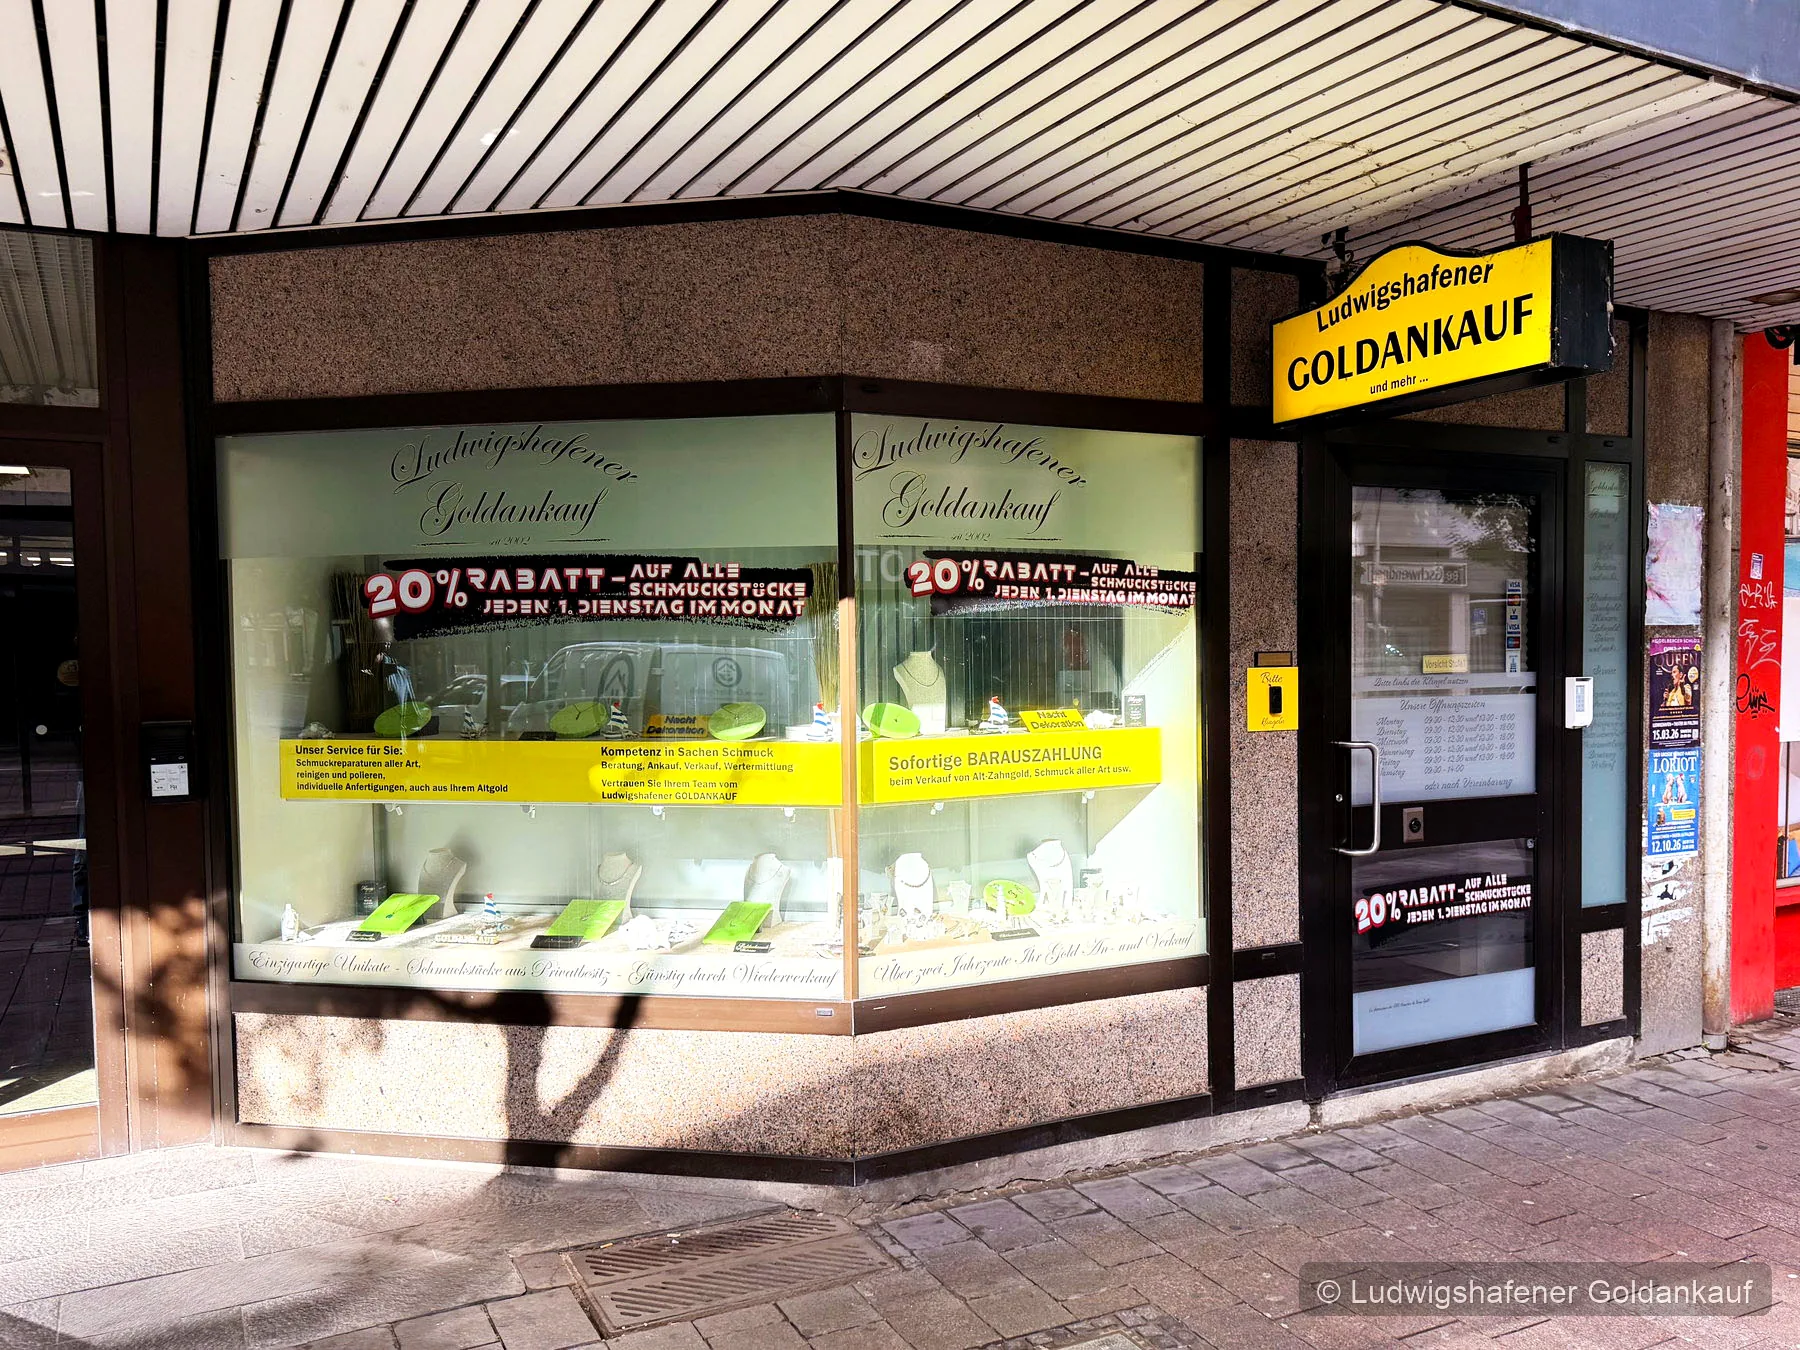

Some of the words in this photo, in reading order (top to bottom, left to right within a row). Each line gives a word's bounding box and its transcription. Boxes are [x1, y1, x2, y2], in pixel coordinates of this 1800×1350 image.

[1315, 261, 1494, 333] Ludwigshafener
[1287, 293, 1534, 392] GOLDANKAUF
[1370, 379, 1388, 394] und
[1390, 375, 1417, 390] mehr
[389, 423, 638, 494] Ludwigshafener
[852, 422, 1087, 489] Ludwigshafener
[420, 480, 609, 537] Goldankauf
[882, 470, 1062, 535] Goldankauf
[965, 531, 992, 542] 2002
[907, 557, 986, 598] 20%
[984, 560, 1077, 582] RABATT
[1091, 562, 1119, 575] AUF
[1124, 563, 1159, 578] ALLE
[1091, 576, 1196, 592] SCHMUCKSTÜCKE
[364, 567, 468, 618] 20%
[468, 567, 606, 592] RABATT
[629, 563, 673, 580] AUF
[682, 562, 740, 580] ALLE
[629, 581, 806, 598] SCHMUCKSTÜCKE
[994, 584, 1040, 600] JEDEN
[1045, 585, 1056, 600] 1.
[1057, 586, 1126, 603] DIENSTAG
[1127, 590, 1146, 605] IM
[1145, 591, 1196, 606] MONAT
[483, 599, 551, 615] JEDEN
[558, 600, 573, 615] 1.
[578, 599, 685, 615] DIENSTAG
[689, 599, 722, 615] IM
[722, 599, 806, 616] MONAT
[1424, 656, 1448, 668] Vorsicht
[1654, 653, 1698, 673] QUEEN
[1260, 672, 1282, 683] Bitte
[1400, 699, 1426, 710] Unsere
[664, 715, 697, 725] Nacht
[1030, 718, 1084, 729] Dekoration
[1036, 711, 1068, 720] Nacht
[1376, 716, 1404, 728] Montag
[1652, 728, 1679, 740] 15.03.26
[295, 745, 325, 755] Unser
[327, 745, 364, 755] Service
[366, 745, 381, 755] für
[383, 745, 404, 755] Sie:
[601, 746, 661, 758] Kompetenz
[664, 746, 675, 757] in
[677, 747, 719, 758] Sachen
[721, 747, 774, 758] Schmuck
[295, 759, 383, 770] Schmuckreparaturen
[384, 759, 404, 768] aller
[889, 754, 963, 771] Sofortige
[967, 746, 1102, 766] BARAUSZAHLUNG
[1653, 757, 1696, 773] LORIOT
[601, 762, 645, 772] Beratung,
[647, 762, 682, 772] Ankauf,
[684, 762, 722, 772] Verkauf,
[724, 762, 794, 773] Wertermittlung
[889, 776, 913, 787] beim
[915, 774, 952, 785] Verkauf
[954, 775, 970, 783] von
[972, 769, 1032, 781] Alt-Zahngold,
[1034, 767, 1075, 777] Schmuck
[1076, 765, 1096, 775] aller
[1097, 764, 1111, 774] Art
[1112, 765, 1132, 774] usw.
[296, 770, 330, 781] reinigen
[331, 770, 348, 779] und
[349, 770, 386, 782] polieren,
[601, 779, 645, 788] Vertrauen
[647, 779, 662, 788] Sie
[664, 779, 690, 788] Ihrem
[692, 779, 717, 788] Team
[719, 781, 738, 789] vom
[296, 782, 343, 792] individuelle
[345, 782, 408, 793] Anfertigungen,
[409, 783, 431, 792] auch
[450, 783, 475, 792] Ihrem
[477, 783, 508, 793] Altgold
[1424, 781, 1440, 791] oder
[601, 791, 673, 802] Ludwigshafener
[674, 791, 738, 801] GOLDANKAUF
[1651, 838, 1681, 853] 12.10.26
[1464, 884, 1532, 903] SCHMUCKSTÜCKE
[1355, 890, 1401, 934] 20%
[1399, 883, 1457, 907] RABATT
[1464, 876, 1482, 890] AUF
[1485, 874, 1508, 887] ALLE
[1406, 908, 1435, 924] JEDEN
[1438, 907, 1445, 920] 1.
[1445, 902, 1488, 919] DIENSTAG
[1488, 900, 1500, 913] IM
[1500, 896, 1532, 911] MONAT
[873, 958, 913, 982] Über
[914, 963, 944, 985] zwei
[943, 954, 1012, 978] Jahrzente
[1014, 945, 1042, 965] Ihr
[1044, 942, 1078, 965] Gold
[1117, 935, 1143, 952] und
[1145, 924, 1196, 950] Verkauf
[248, 950, 330, 978] Einzigartige
[333, 950, 390, 973] Unikate
[406, 957, 503, 978] Schmuckstücke
[505, 965, 527, 977] aus
[531, 958, 612, 985] Privatbesitz
[628, 960, 686, 988] Günstig
[689, 967, 727, 982] durch
[732, 961, 840, 988] Wiederverkauf
